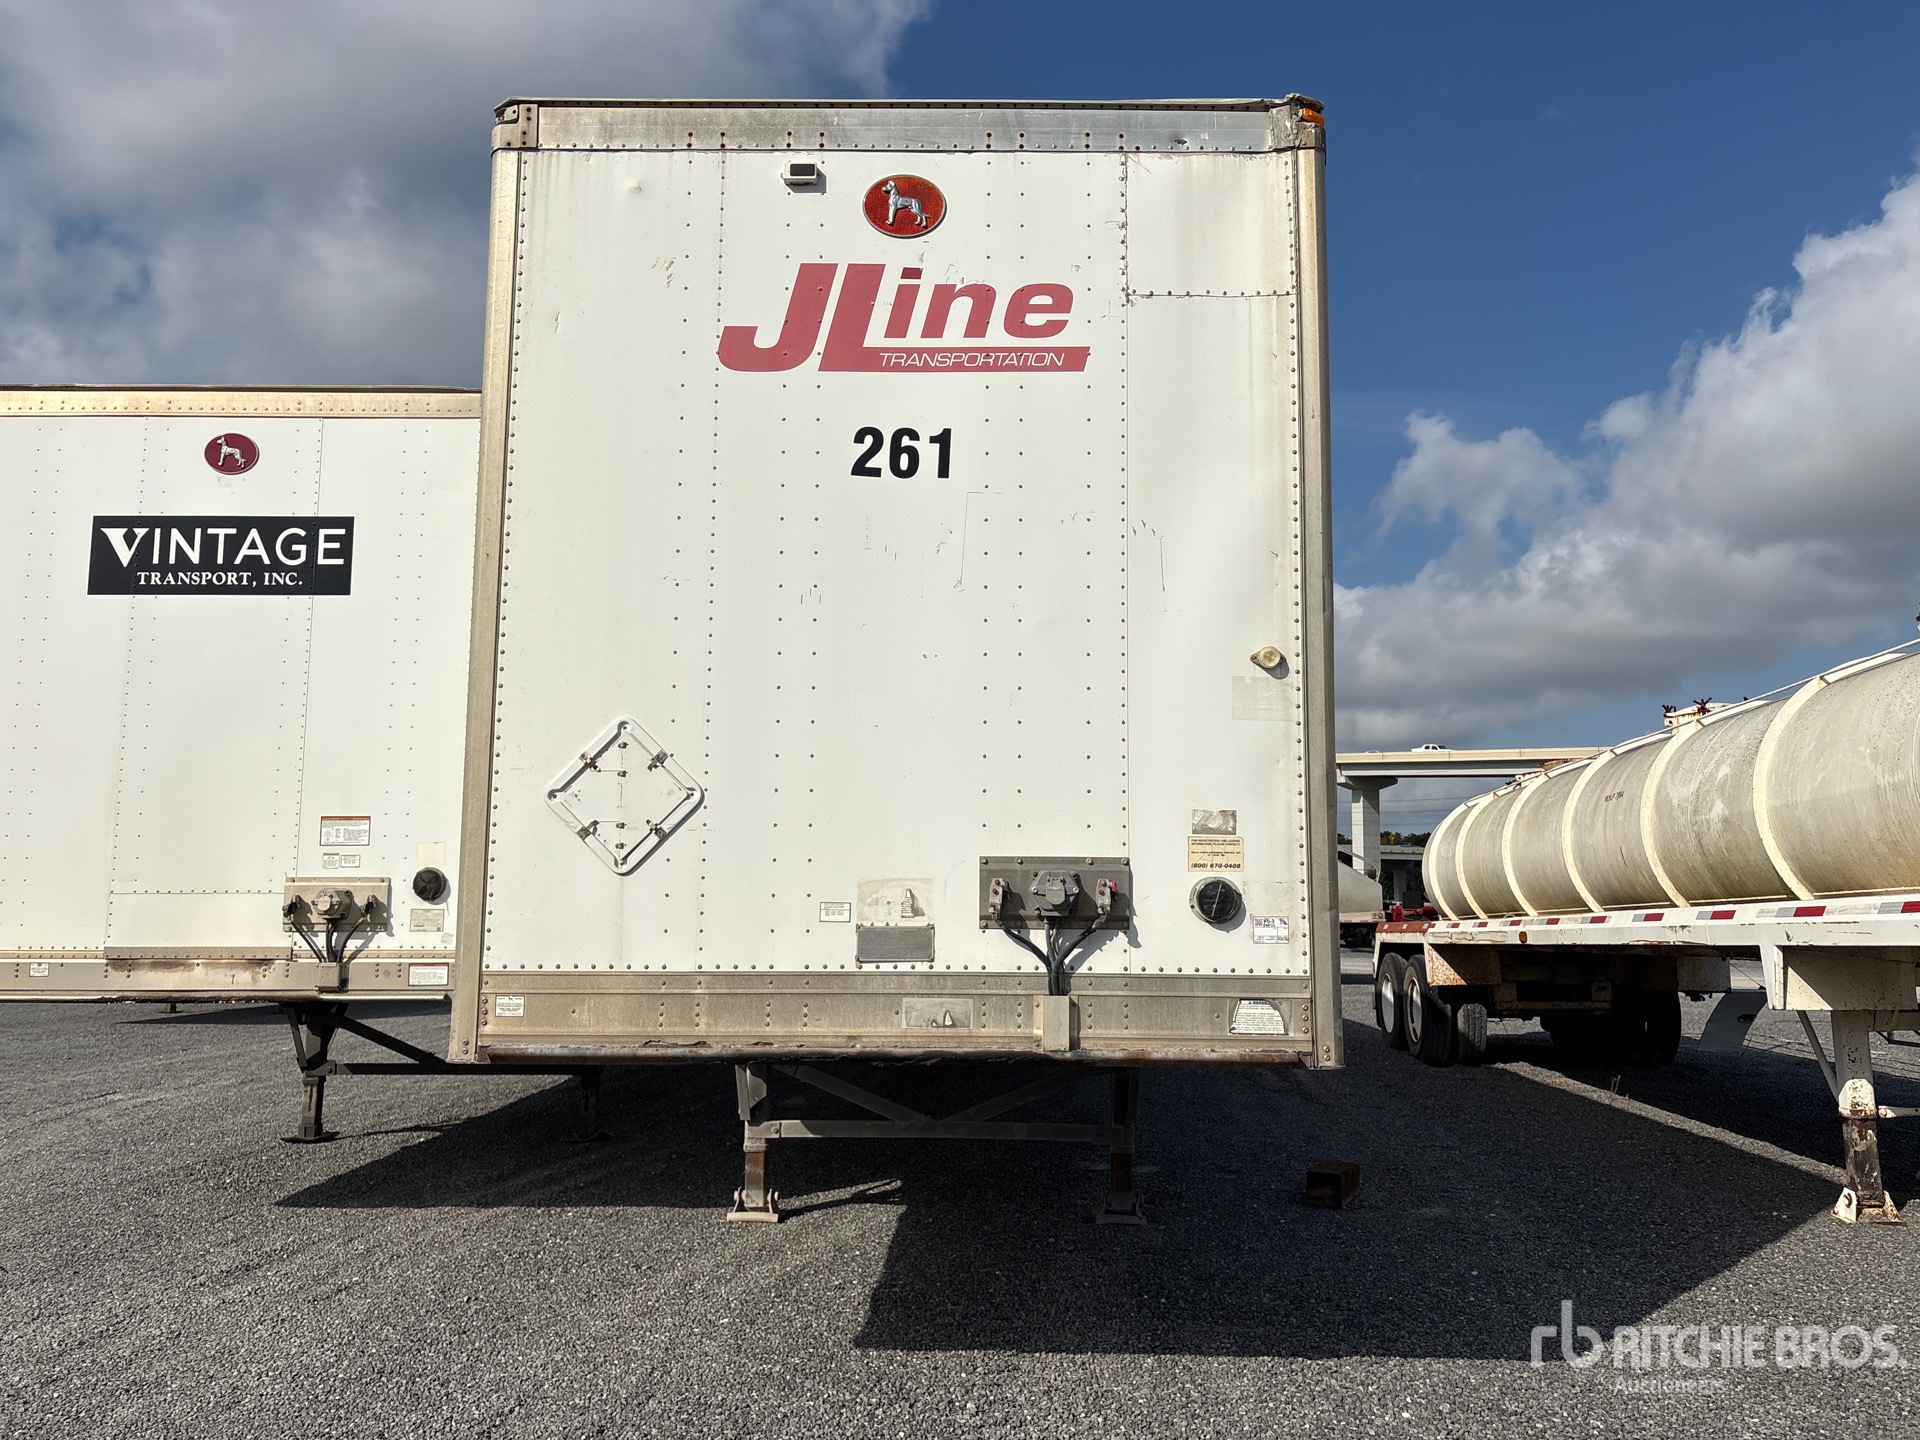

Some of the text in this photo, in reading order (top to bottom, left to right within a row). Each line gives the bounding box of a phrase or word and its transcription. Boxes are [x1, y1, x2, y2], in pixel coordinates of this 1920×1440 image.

[879, 352, 1066, 368] TRANSPORTATION
[850, 426, 952, 479] 261
[99, 527, 347, 568] VINTAGE
[136, 571, 304, 588] TRANSPORT, INC.
